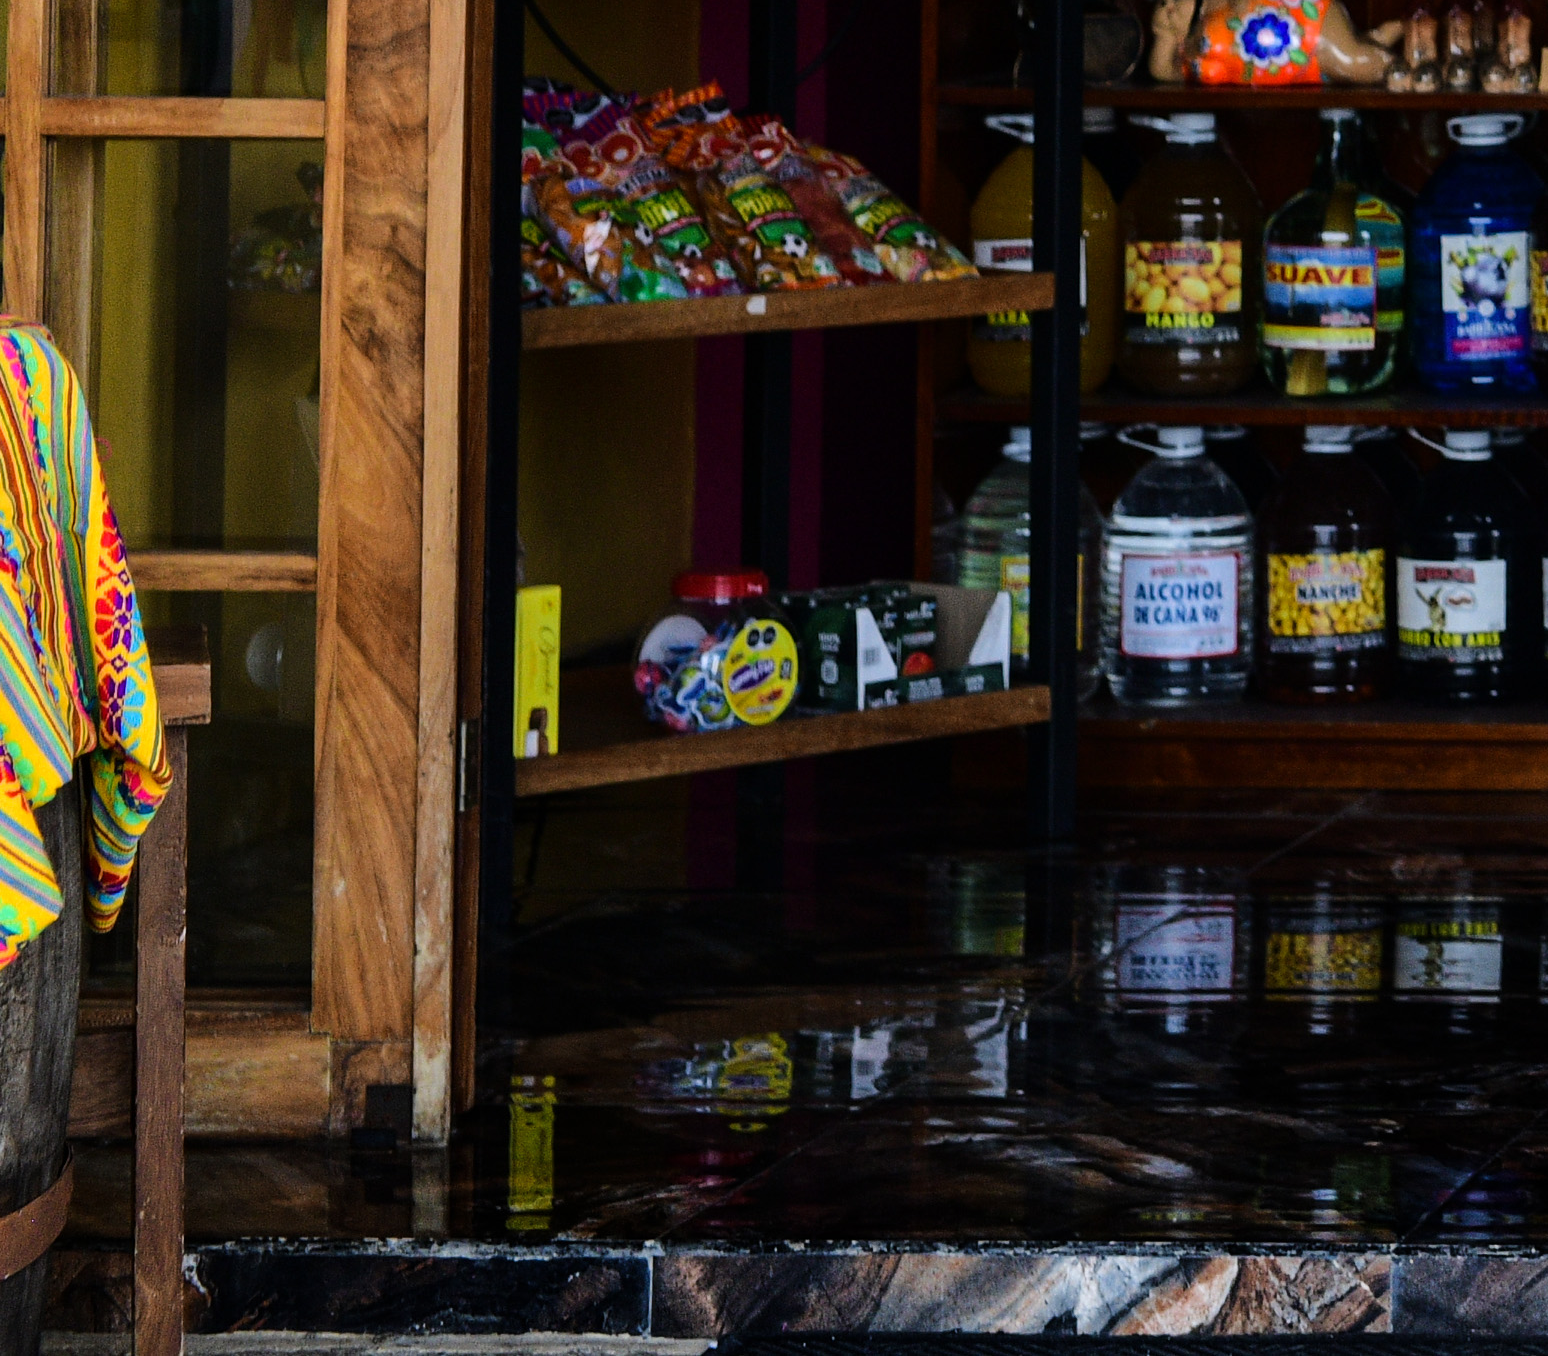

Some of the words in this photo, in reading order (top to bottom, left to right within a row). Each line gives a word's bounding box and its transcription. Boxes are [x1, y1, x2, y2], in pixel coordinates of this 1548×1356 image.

[1265, 263, 1371, 286] SUAVE
[1145, 312, 1215, 329] MANGO
[1134, 580, 1223, 601] ALCOHOL
[1134, 606, 1149, 624] DE
[1154, 603, 1198, 624] CAÑA
